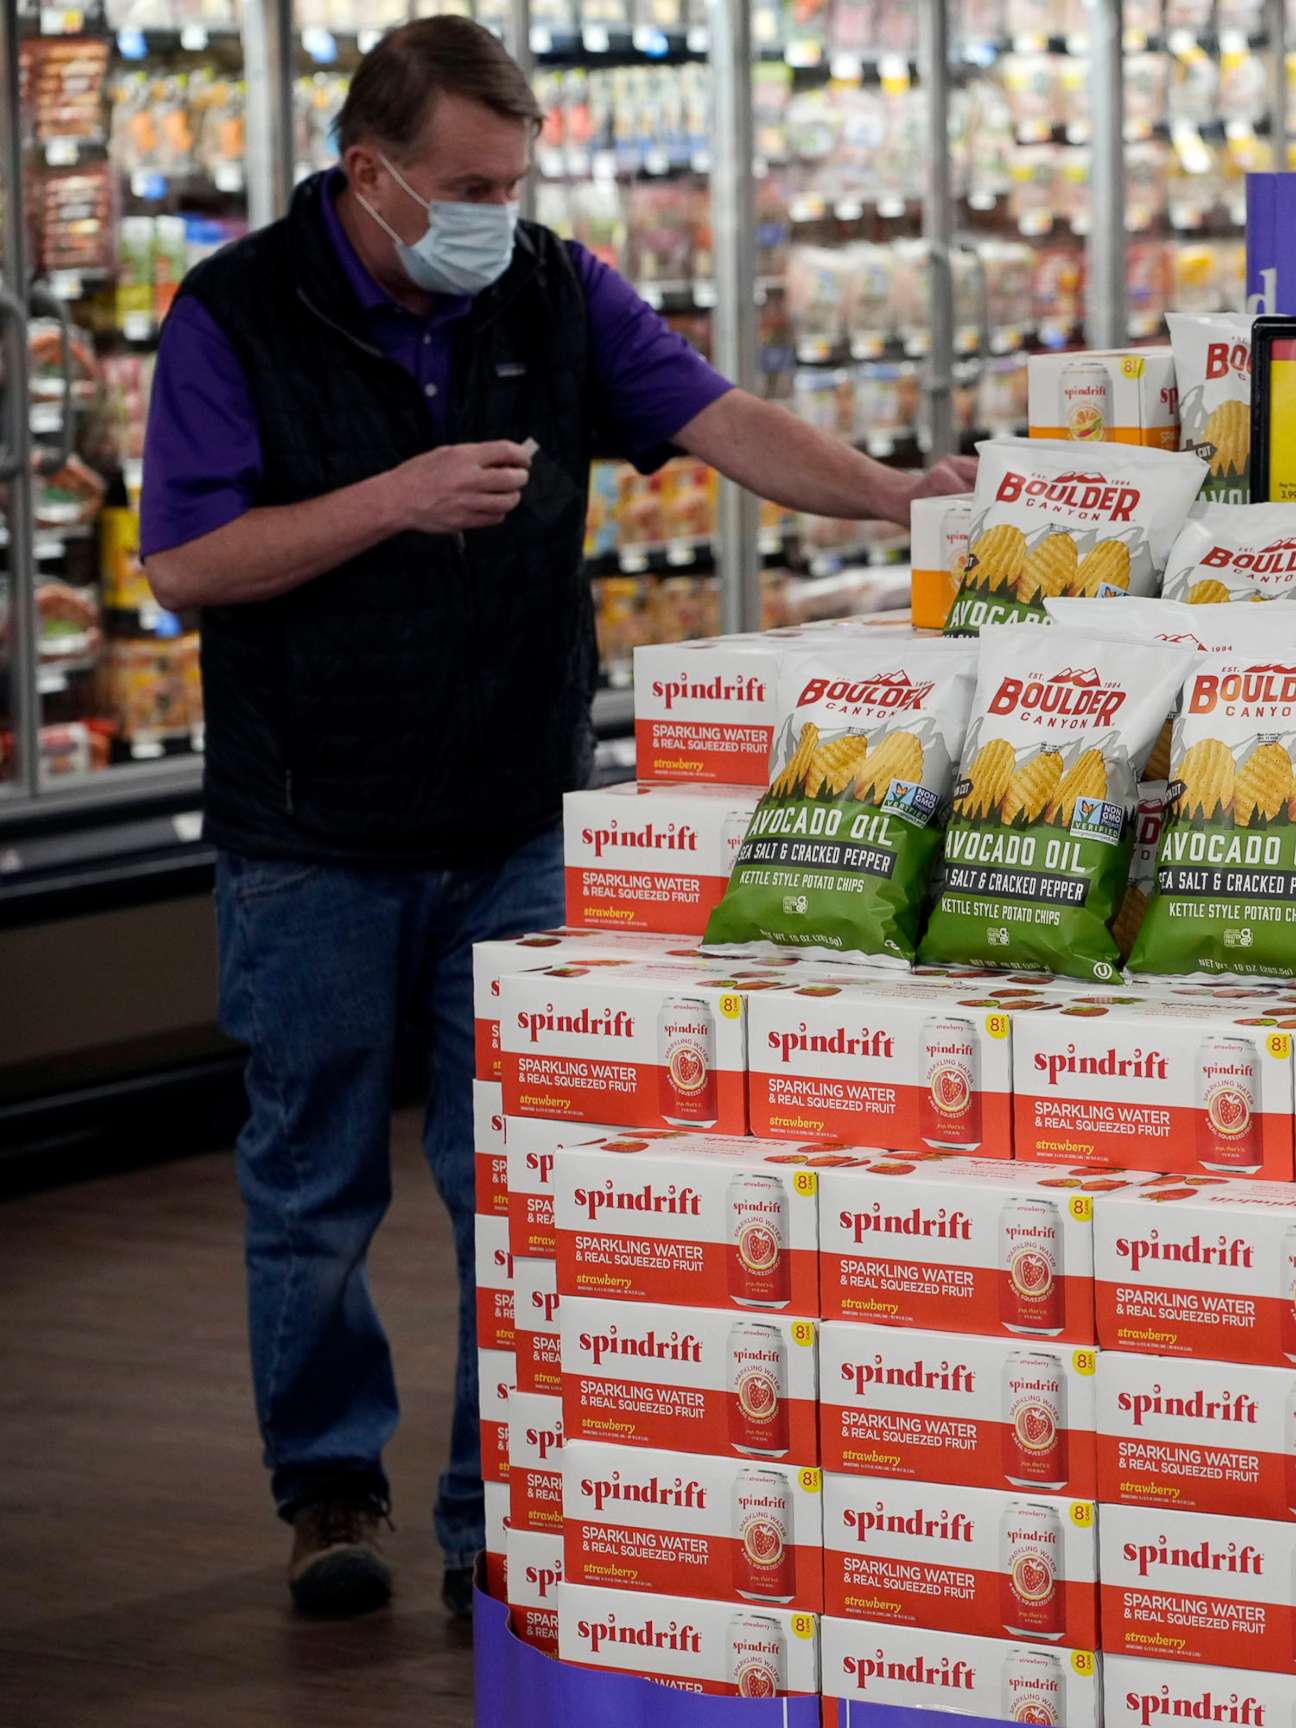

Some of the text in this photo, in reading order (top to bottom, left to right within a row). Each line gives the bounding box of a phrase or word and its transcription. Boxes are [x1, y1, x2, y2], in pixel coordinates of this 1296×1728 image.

[995, 471, 1141, 522] BOULDER
[1026, 498, 1101, 522] CANYON
[652, 672, 765, 709] spindrift
[1028, 672, 1044, 680] EST.
[796, 678, 935, 712] BOULDER
[988, 677, 1126, 728] BOULDER
[1020, 712, 1088, 728] CANYON
[887, 801, 927, 820] VERIFIED
[915, 795, 934, 808] GMO
[918, 788, 936, 802] NON
[1104, 805, 1122, 815] NON
[749, 807, 893, 846] AVOCADO OIL
[1075, 822, 1118, 837] VERIFIED
[1103, 813, 1120, 822] GMO
[582, 820, 698, 857] spindrift
[945, 831, 1086, 873] AVOCADO OIL
[1161, 832, 1281, 865] AVOCADO
[755, 843, 778, 860] SALT
[780, 845, 787, 860] &
[791, 845, 840, 864] CRACKED
[844, 850, 891, 872] PEPPER
[740, 871, 864, 893] KETTLE STYLE POTATO CHIPS
[950, 869, 1084, 900] SALT & CRACKED PEPPER
[1179, 872, 1208, 890] SALT
[1214, 874, 1221, 891] &
[1227, 874, 1284, 893] CRACKED
[942, 898, 1060, 926] KETTLE STYLE POTATO CHIPS
[1169, 903, 1204, 918] KETTLE
[1208, 904, 1238, 919] STYLE
[1245, 906, 1281, 921] POTATO
[517, 1003, 636, 1042] spindrift
[767, 1022, 895, 1062] spindrift
[1034, 1043, 1169, 1085] spindrift
[574, 1180, 702, 1220] spindrift
[839, 1202, 973, 1244] spindrift
[575, 1237, 703, 1259] SPARKLING WATER
[1115, 1229, 1253, 1272] spindrift
[576, 1273, 632, 1290] strawberry
[578, 1324, 703, 1364] spindrift
[840, 1355, 976, 1395] spindrift
[1118, 1384, 1259, 1426] spindrift
[580, 1470, 707, 1510] spindrift
[843, 1502, 974, 1543] spindrift
[1123, 1535, 1264, 1576] spindrift
[577, 1614, 702, 1652] spindrift
[843, 1649, 976, 1690] spindrift
[1126, 1684, 1265, 1726] spindrift
